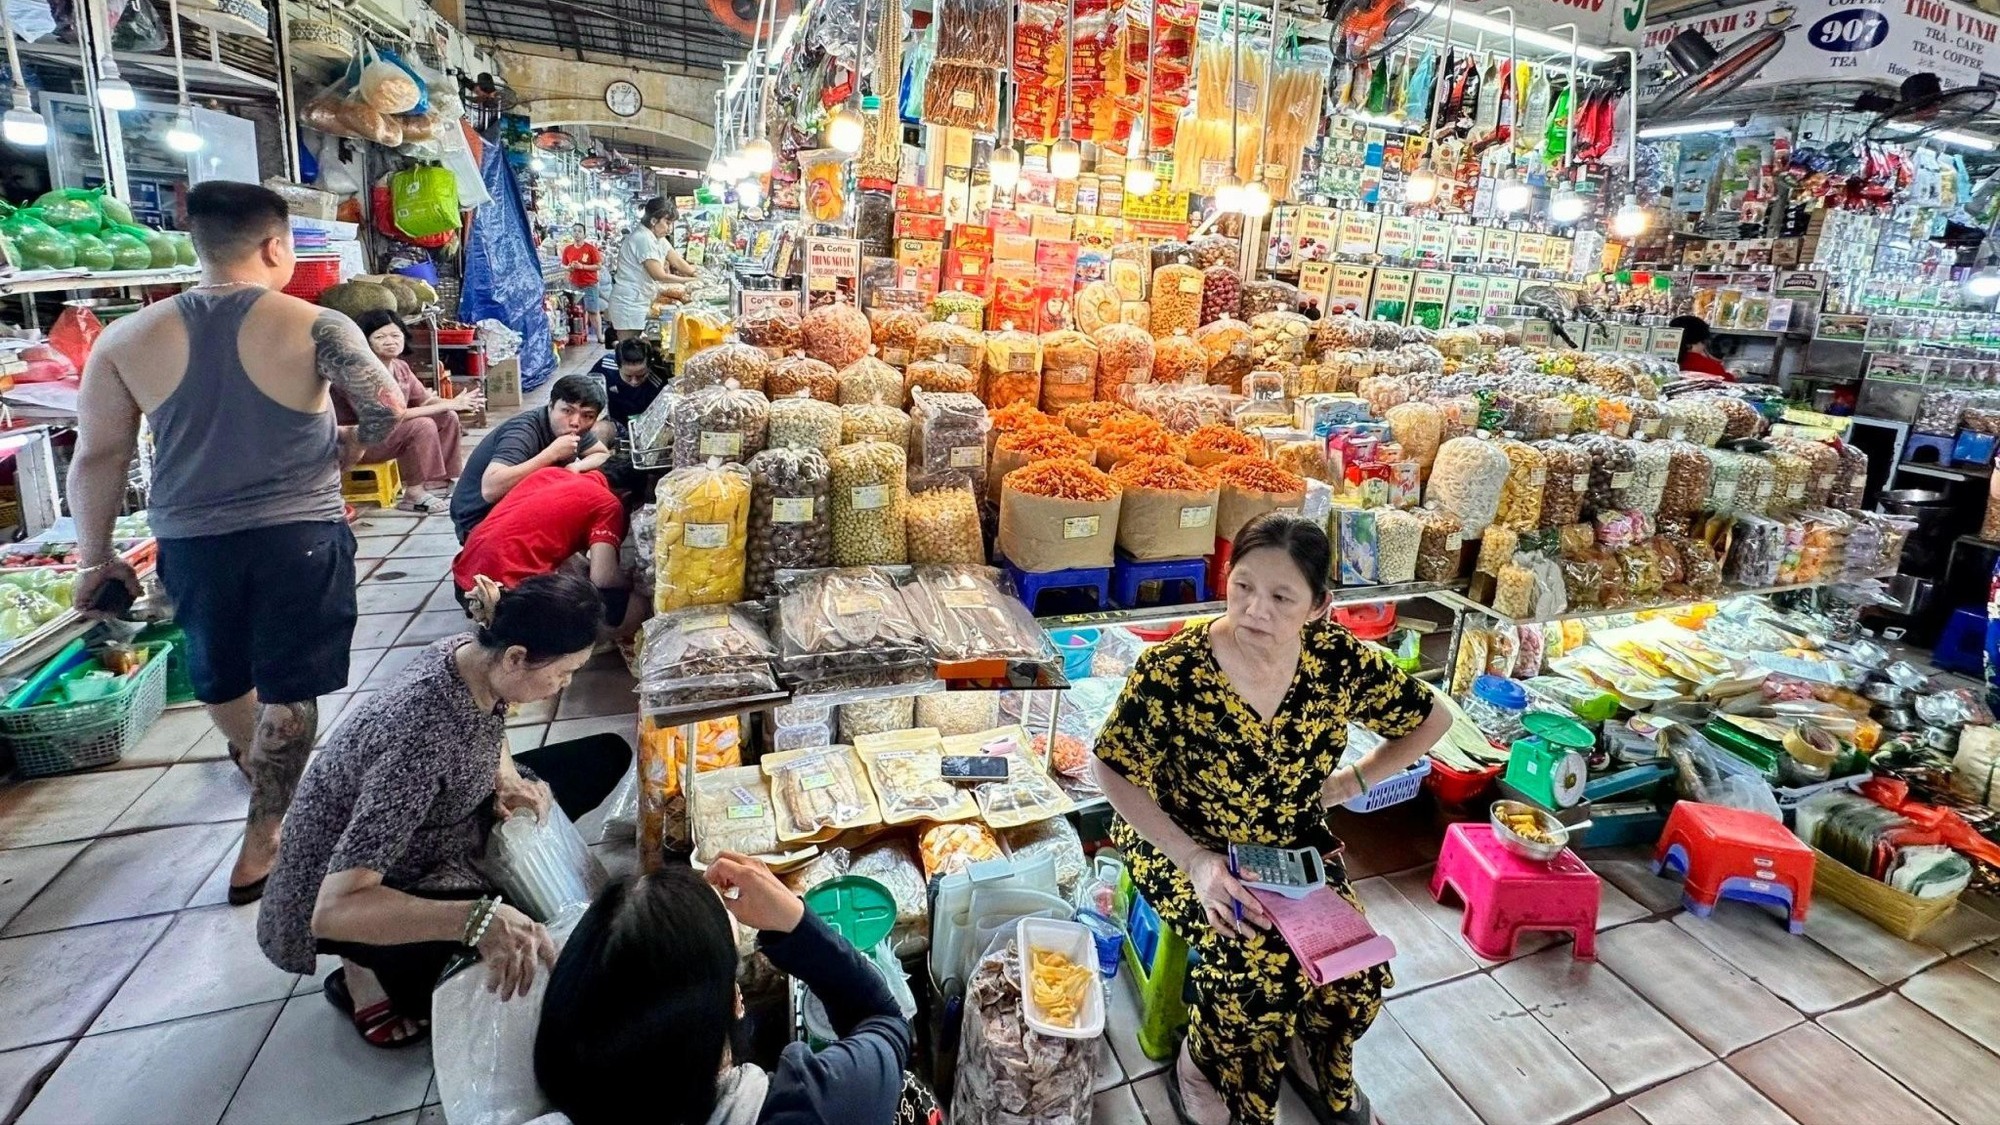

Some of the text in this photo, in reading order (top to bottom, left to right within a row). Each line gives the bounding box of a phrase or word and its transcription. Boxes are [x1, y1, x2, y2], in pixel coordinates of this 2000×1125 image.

[1643, 22, 1681, 48] HỜI
[1743, 10, 1757, 28] 3
[1820, 18, 1883, 43] 907
[1957, 12, 1998, 43] VINH
[1830, 56, 1857, 67] TEA
[1912, 40, 1984, 70] TEA COFFEE
[827, 244, 852, 254] Coffee
